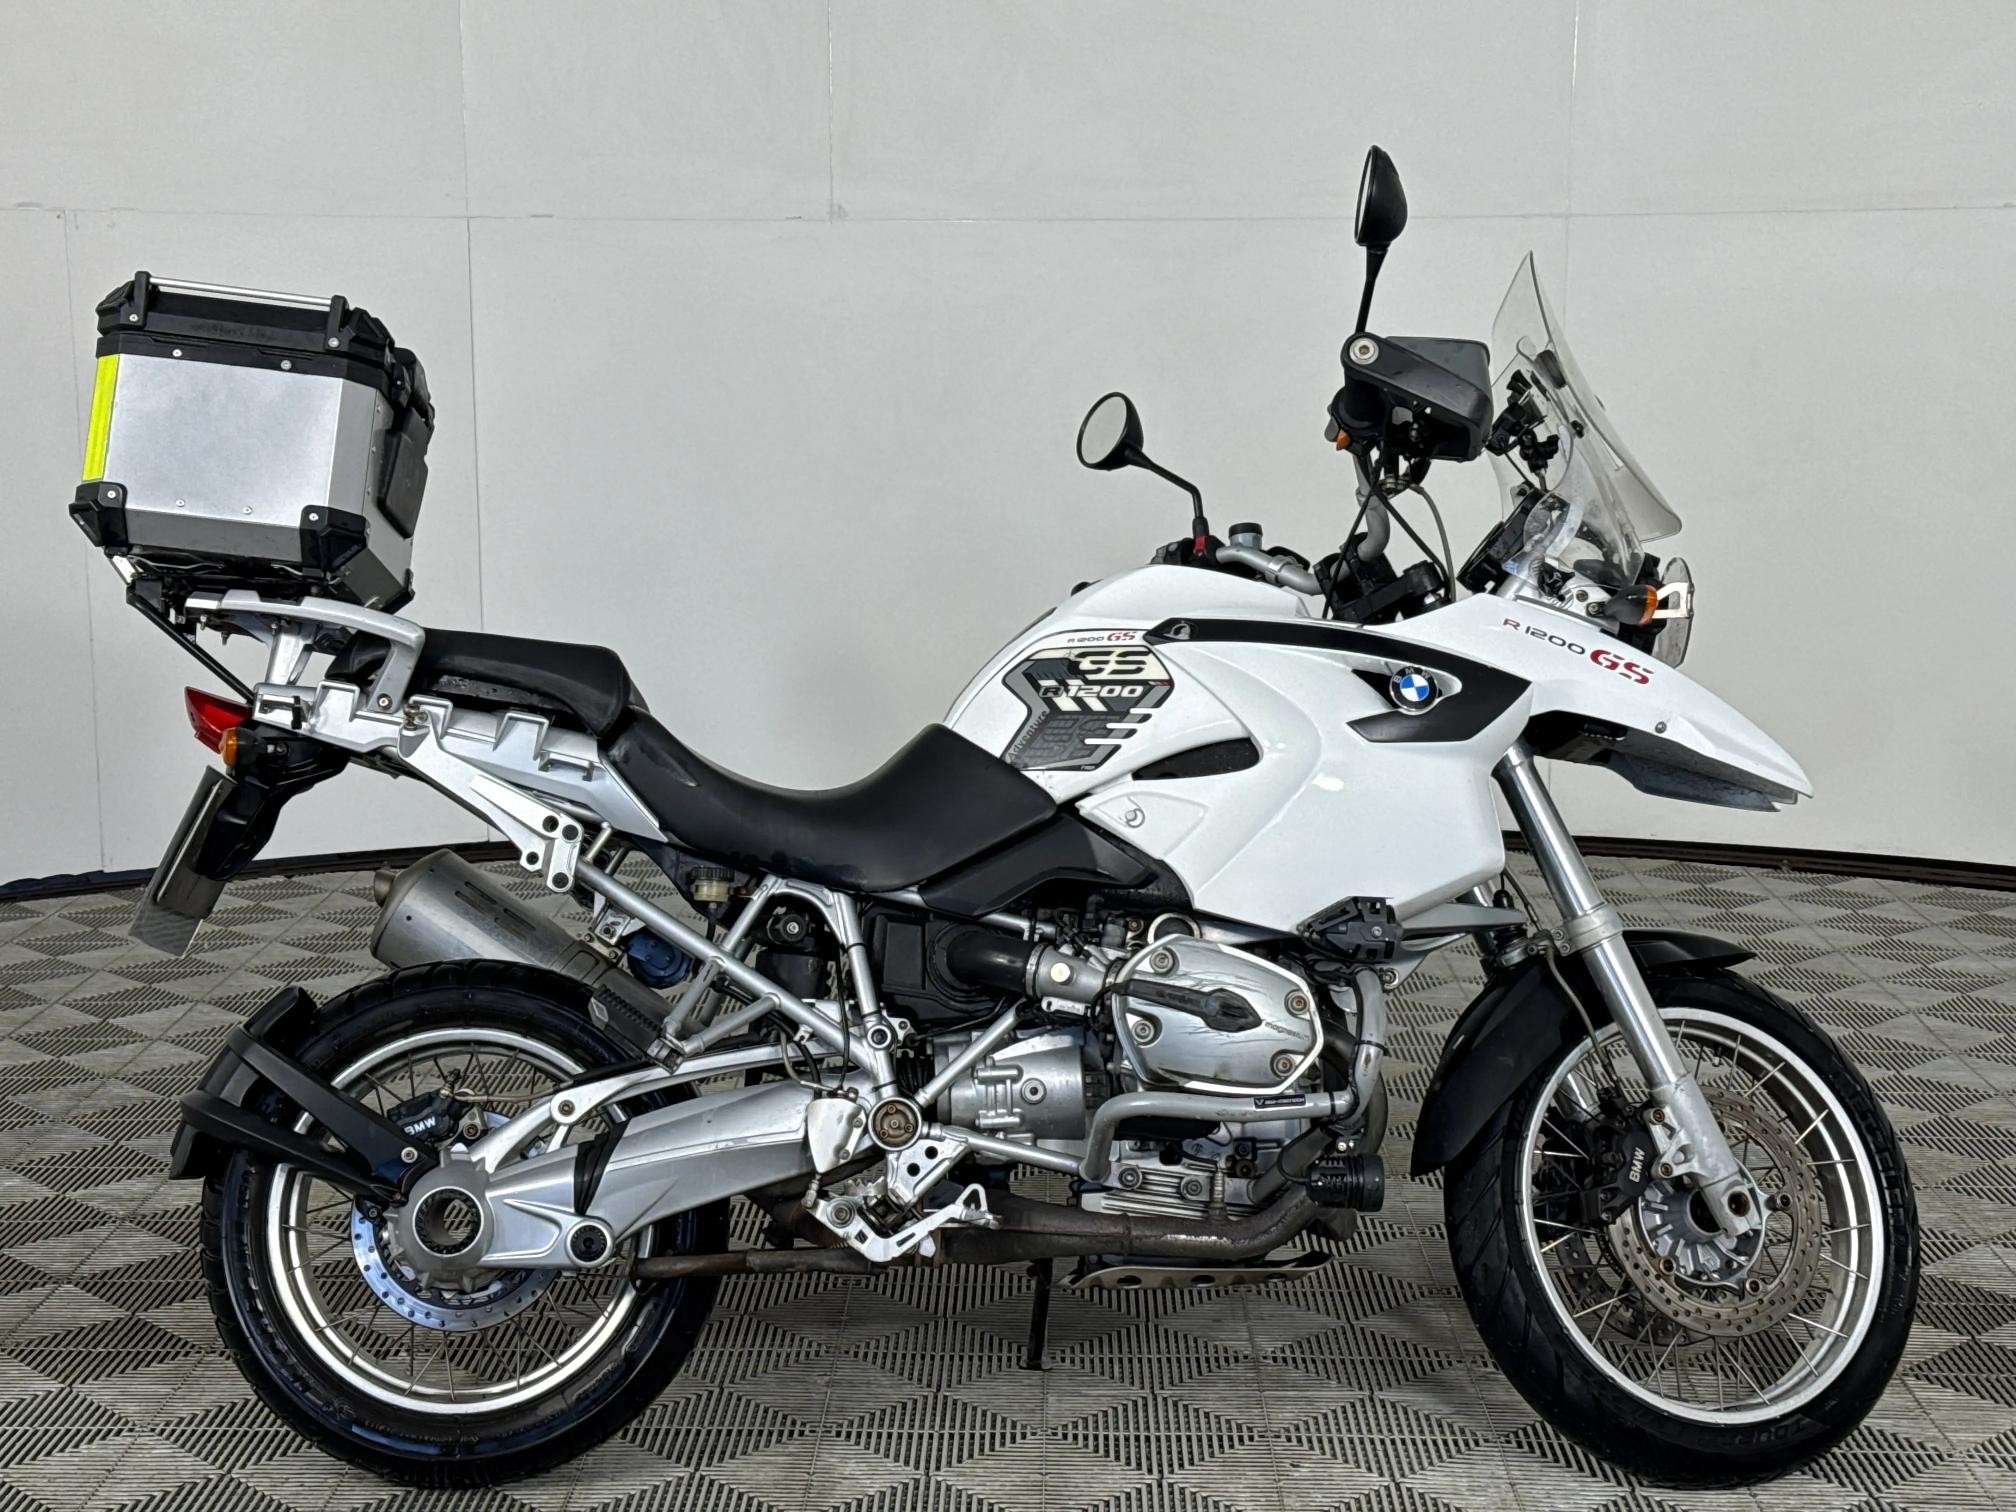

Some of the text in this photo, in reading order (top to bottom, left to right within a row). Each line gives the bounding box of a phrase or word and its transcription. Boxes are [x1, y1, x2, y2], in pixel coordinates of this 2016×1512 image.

[1106, 631, 1138, 642] GS
[1502, 618, 1655, 685] R 1200 GS
[404, 1116, 436, 1136] BMW
[1628, 1146, 1646, 1183] BMW
